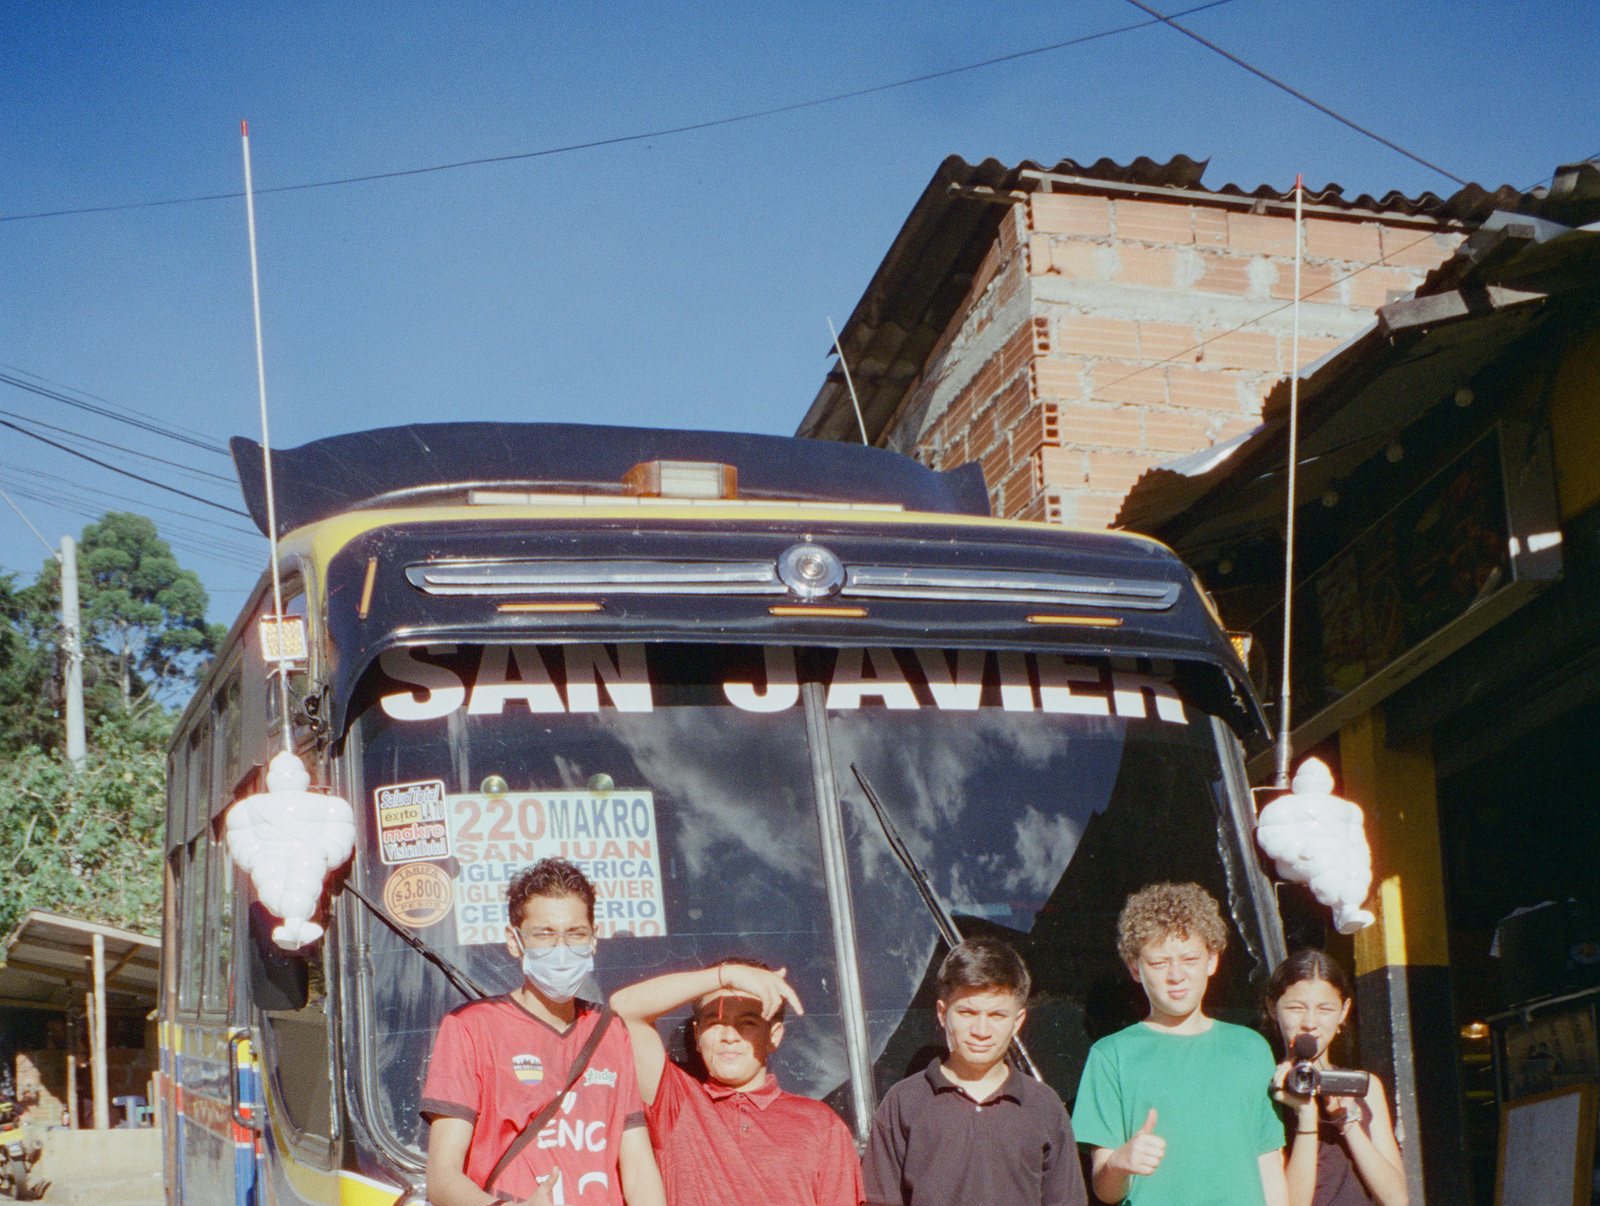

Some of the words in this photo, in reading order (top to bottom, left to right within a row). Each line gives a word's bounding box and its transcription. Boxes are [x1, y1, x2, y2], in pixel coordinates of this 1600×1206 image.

[380, 643, 652, 721] SAN
[723, 645, 1188, 725] JAVIER
[454, 799, 547, 842] 220
[548, 798, 650, 839] MAKRO
[383, 824, 445, 844] makro
[456, 842, 535, 864] SAN
[552, 840, 652, 860] JUAN
[576, 860, 655, 879] ERICA
[395, 879, 441, 902] $3.800
[595, 880, 656, 899] AVIER
